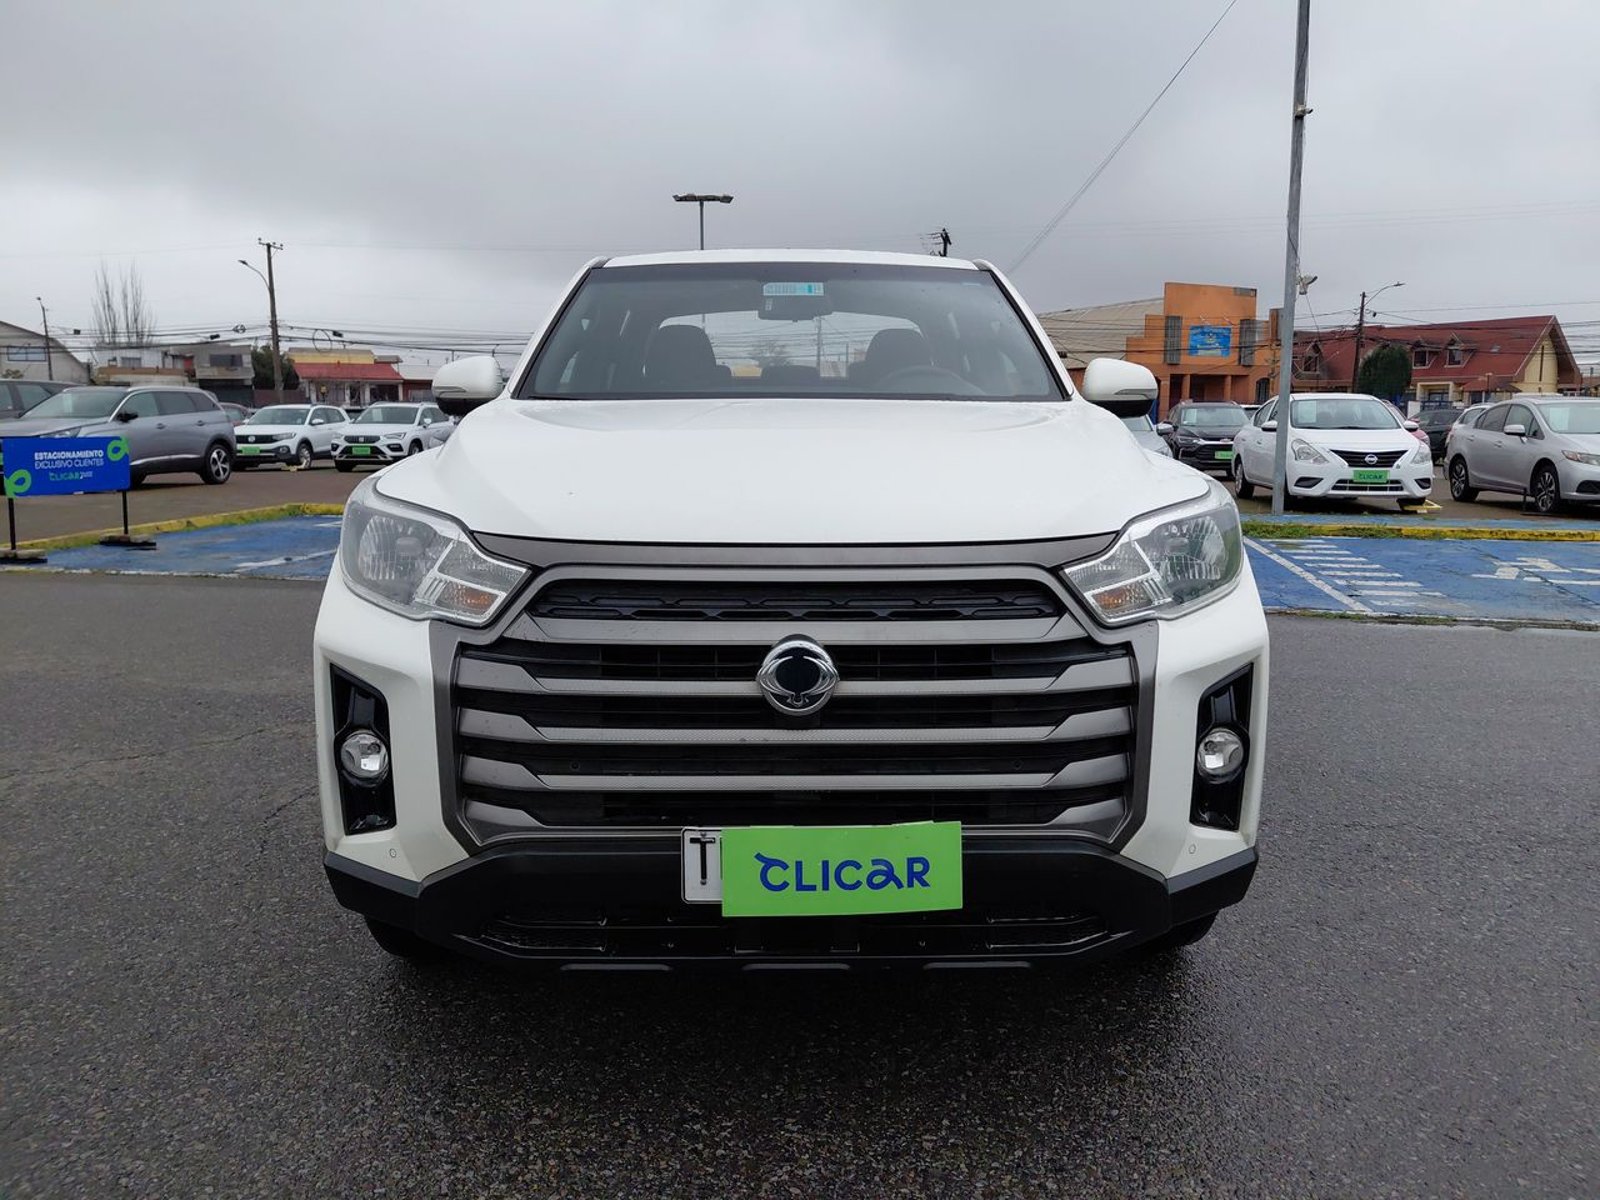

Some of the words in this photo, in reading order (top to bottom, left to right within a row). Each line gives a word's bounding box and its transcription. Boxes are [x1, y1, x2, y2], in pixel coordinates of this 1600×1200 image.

[34, 450, 104, 460] ESTACIONAMIENTO
[34, 460, 73, 470] EXCLUSIVO
[74, 459, 104, 467] CLIENTES
[689, 836, 722, 886] T
